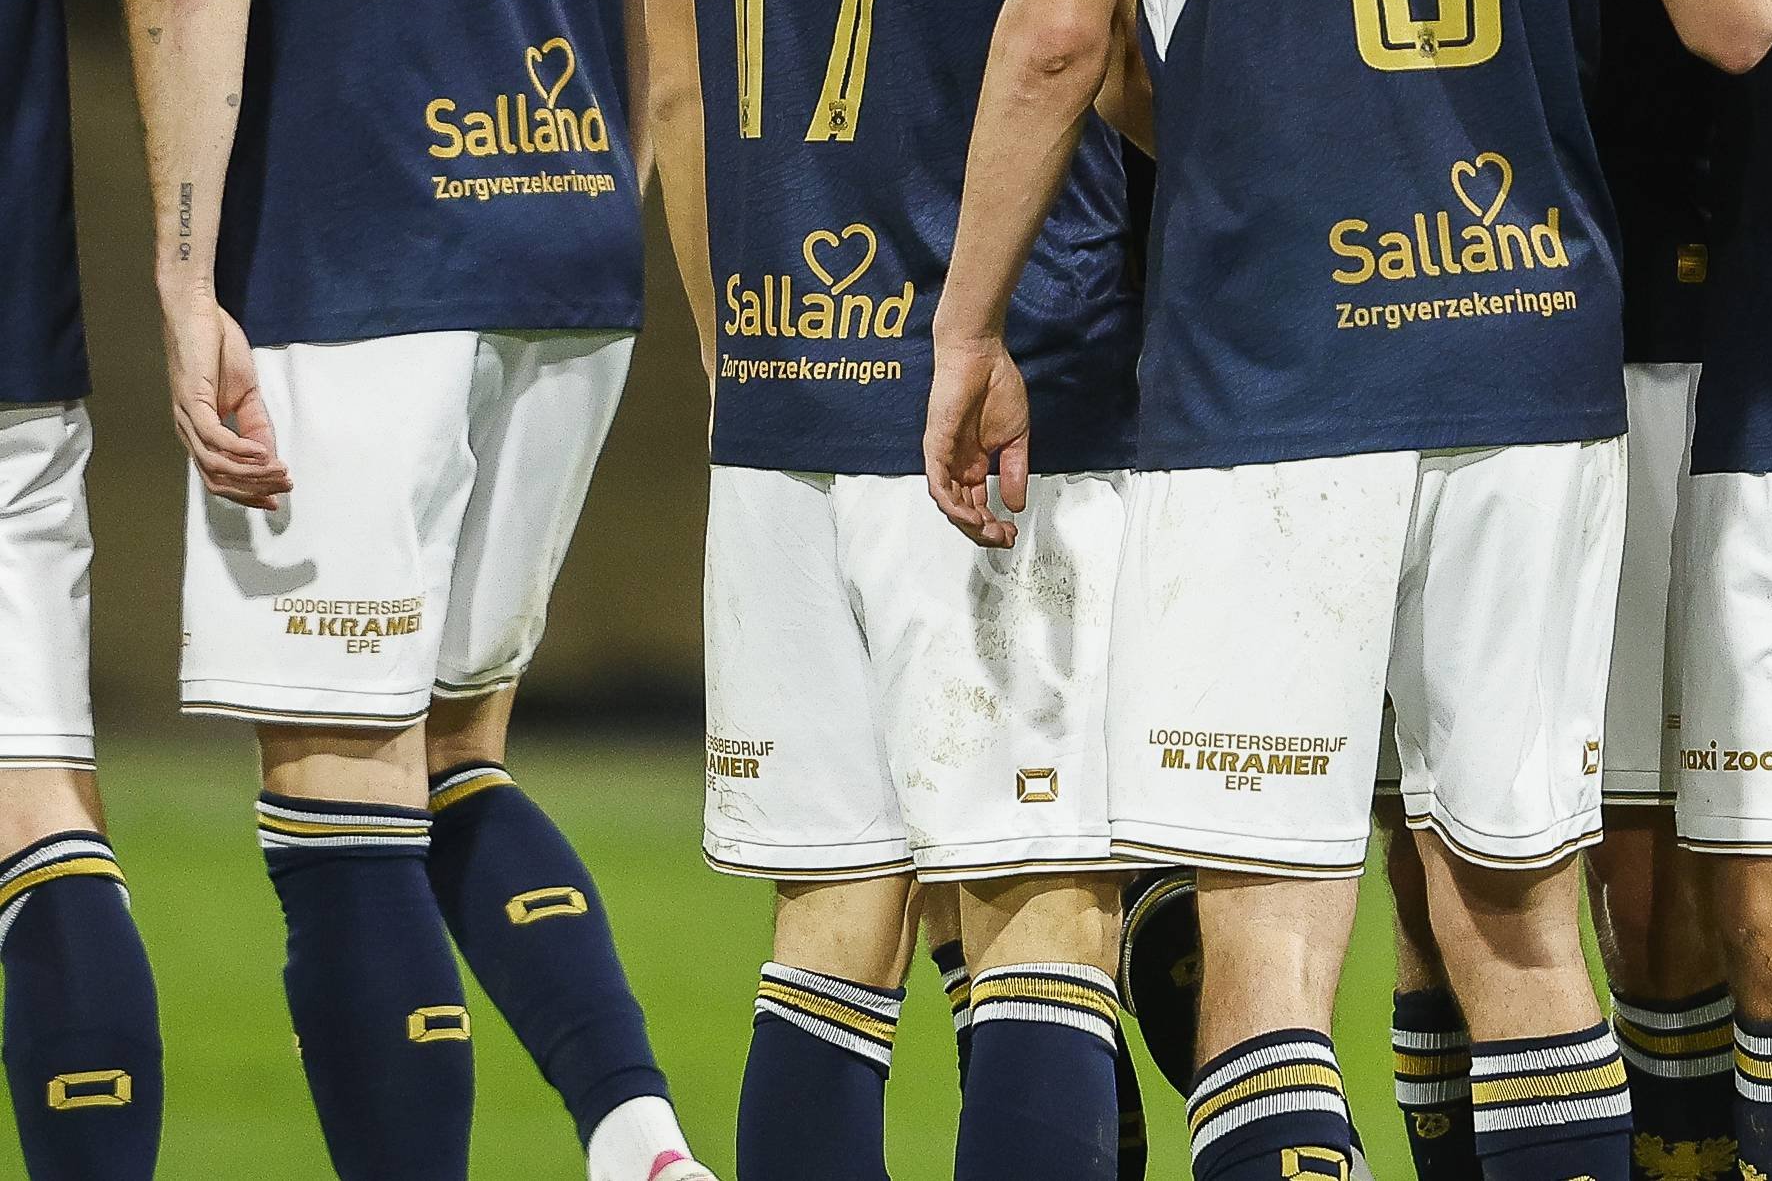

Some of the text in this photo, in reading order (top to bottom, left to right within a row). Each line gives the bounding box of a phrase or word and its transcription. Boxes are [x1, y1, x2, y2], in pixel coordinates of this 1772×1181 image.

[425, 93, 610, 158] Salland
[431, 170, 616, 201] Zorgverzekeringen
[1329, 207, 1570, 285] Salland
[725, 274, 915, 339] Salland
[1336, 288, 1577, 330] Zorgverzekeringen
[721, 354, 901, 385] Zorgverzekeringen
[346, 639, 381, 654] EPE
[1149, 729, 1348, 753] LOODGIETERSBEDRIJF
[1161, 748, 1330, 775] M. KRAMER
[1225, 775, 1262, 792] EPE
